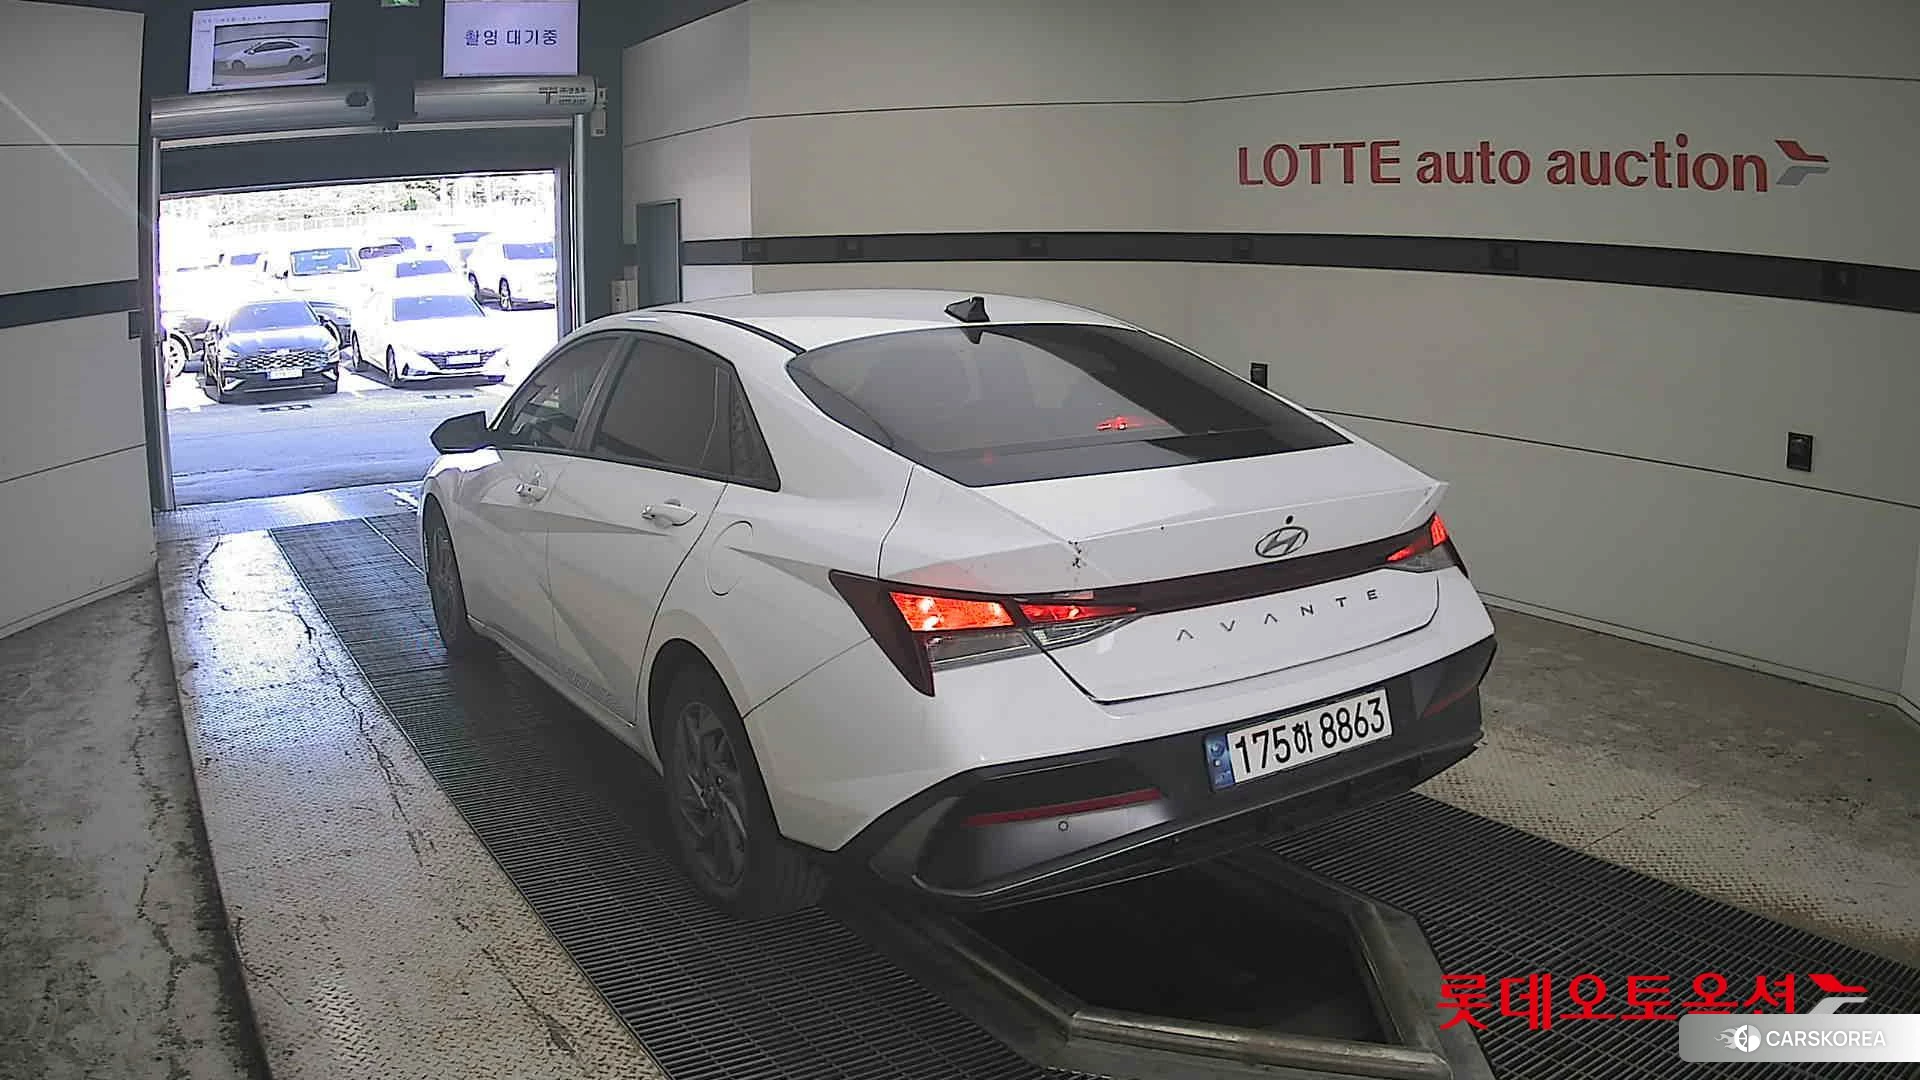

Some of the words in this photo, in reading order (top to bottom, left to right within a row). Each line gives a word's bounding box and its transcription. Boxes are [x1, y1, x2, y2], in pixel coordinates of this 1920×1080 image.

[506, 29, 558, 46] 대기중
[1238, 139, 1401, 186] LOTTE
[1416, 140, 1531, 186] auto
[1546, 133, 1769, 192] auction
[1176, 589, 1379, 641] AVANTE
[1235, 722, 1314, 775] 175하
[1319, 697, 1386, 750] 8863
